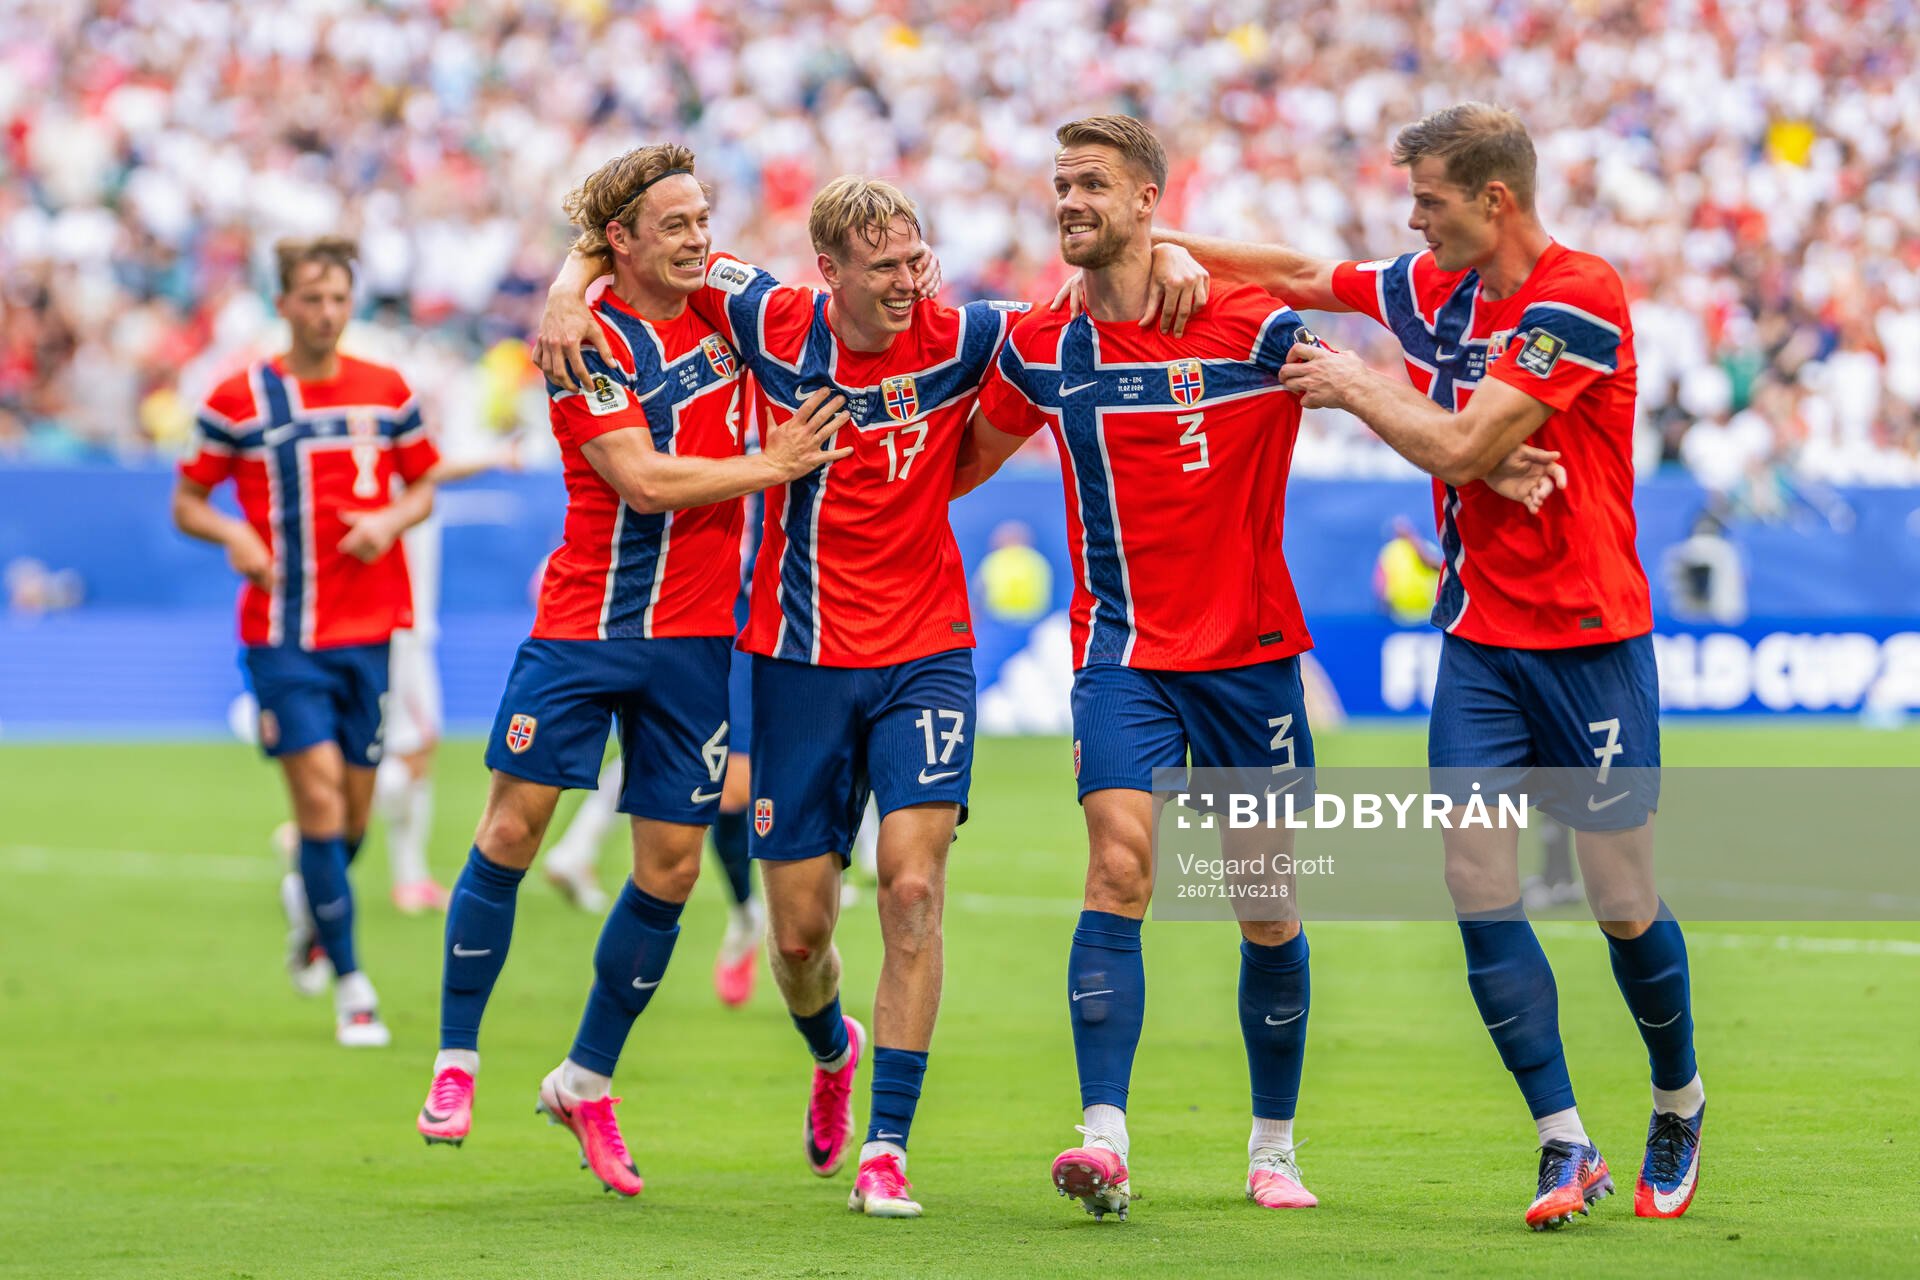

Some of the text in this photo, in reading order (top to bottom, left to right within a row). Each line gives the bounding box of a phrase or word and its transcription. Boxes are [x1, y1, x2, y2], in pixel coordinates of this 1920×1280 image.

[879, 420, 929, 483] 17
[1177, 411, 1210, 473] 3
[702, 720, 729, 783] 6
[915, 709, 965, 765] 17
[1268, 713, 1296, 775] 3
[1588, 718, 1624, 785] 7
